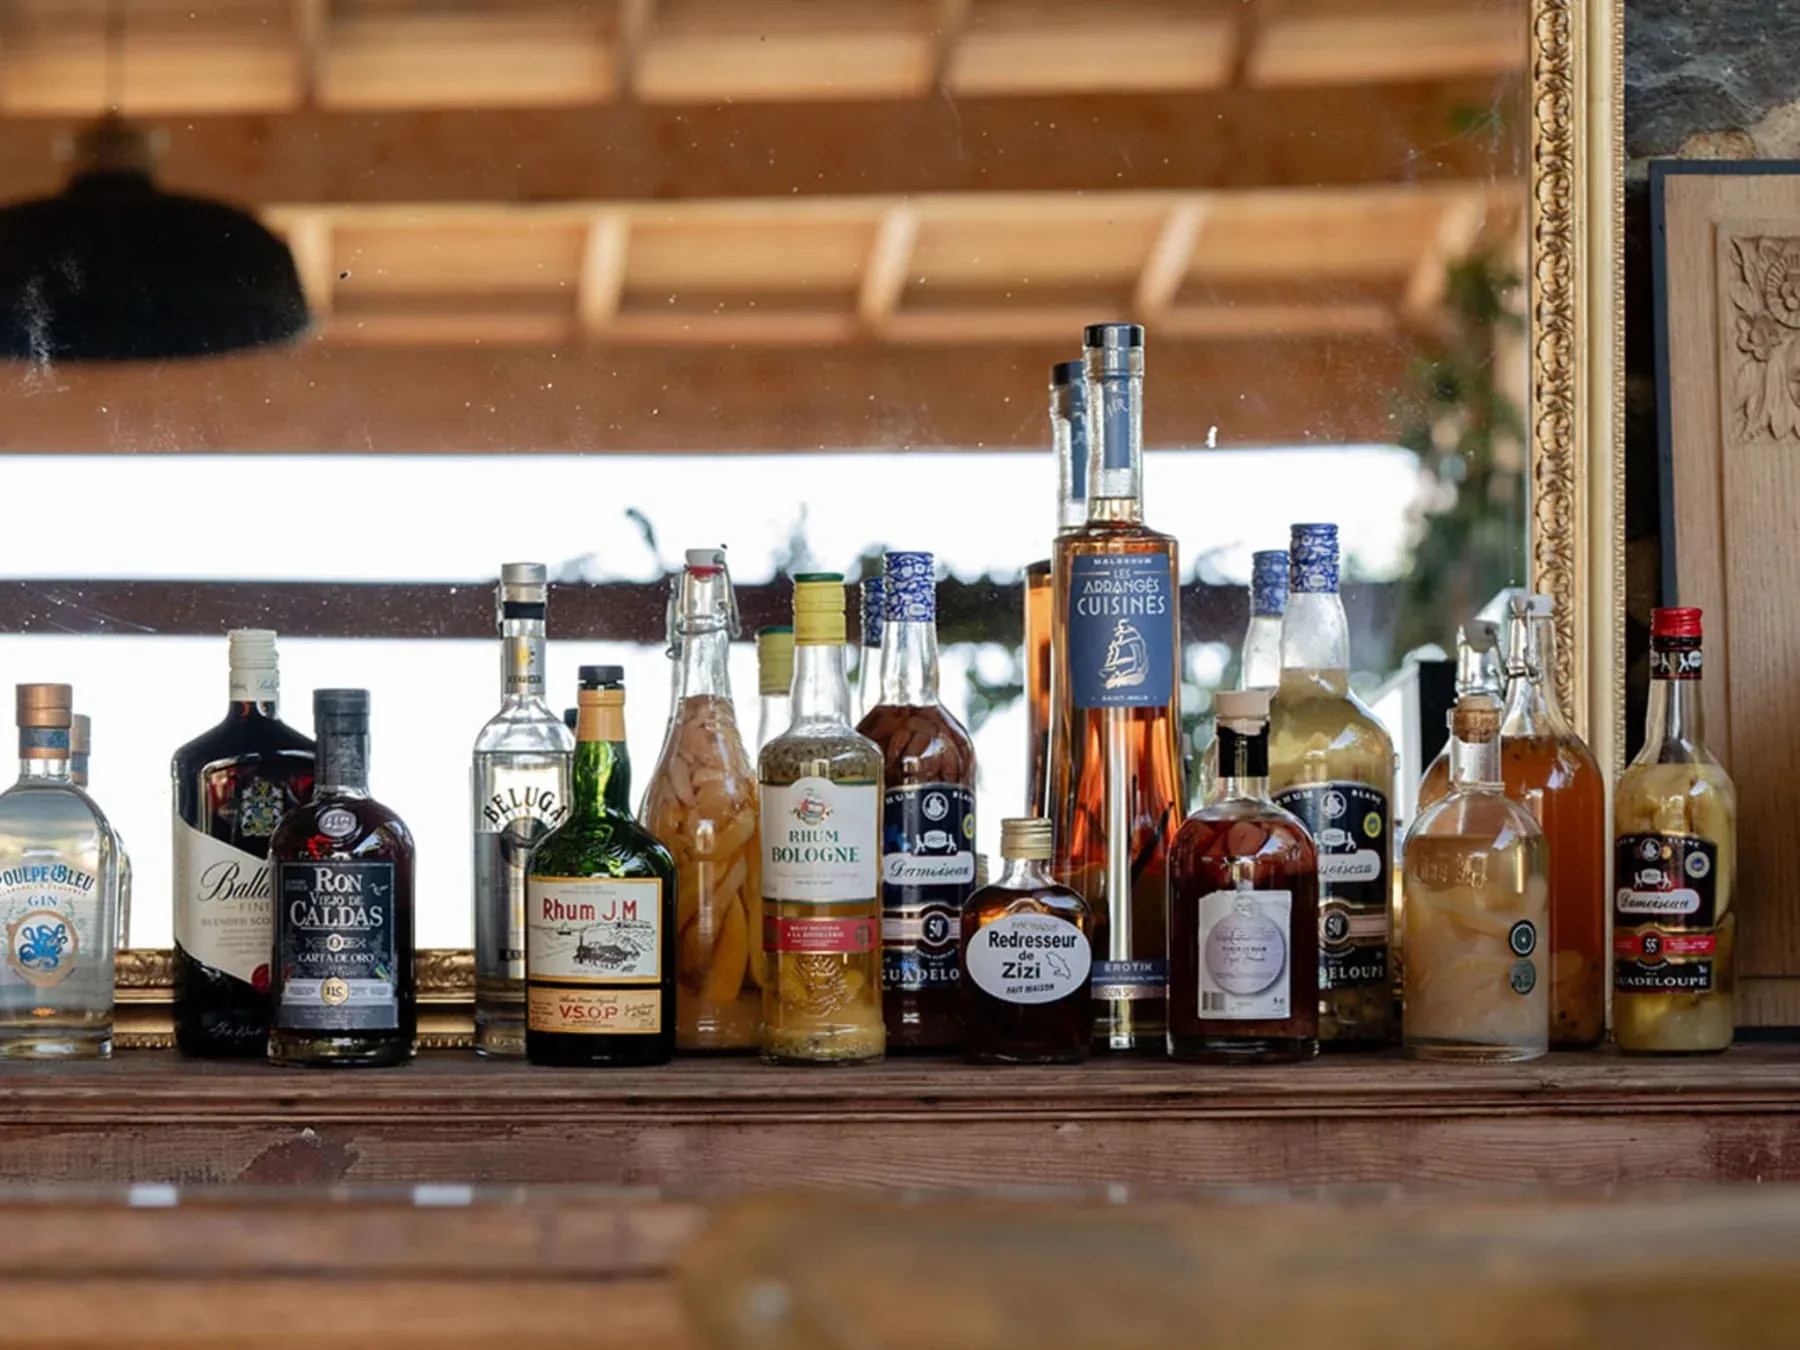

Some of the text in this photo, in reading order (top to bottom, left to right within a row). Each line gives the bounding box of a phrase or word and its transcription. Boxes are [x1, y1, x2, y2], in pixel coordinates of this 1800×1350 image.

[1113, 568, 1131, 579] LES
[483, 786, 568, 824] BELUGA
[789, 830, 839, 843] RHUM
[771, 846, 860, 863] BOLOGNE
[314, 867, 363, 893] RON
[27, 895, 58, 907] GIN
[348, 895, 364, 906] DE
[290, 900, 384, 927] CALDAS
[543, 898, 638, 921] Rhum J.M
[988, 930, 1077, 948] Redresseur
[350, 952, 375, 963] ORO
[1018, 950, 1034, 960] de
[1002, 962, 1040, 979] Zizi
